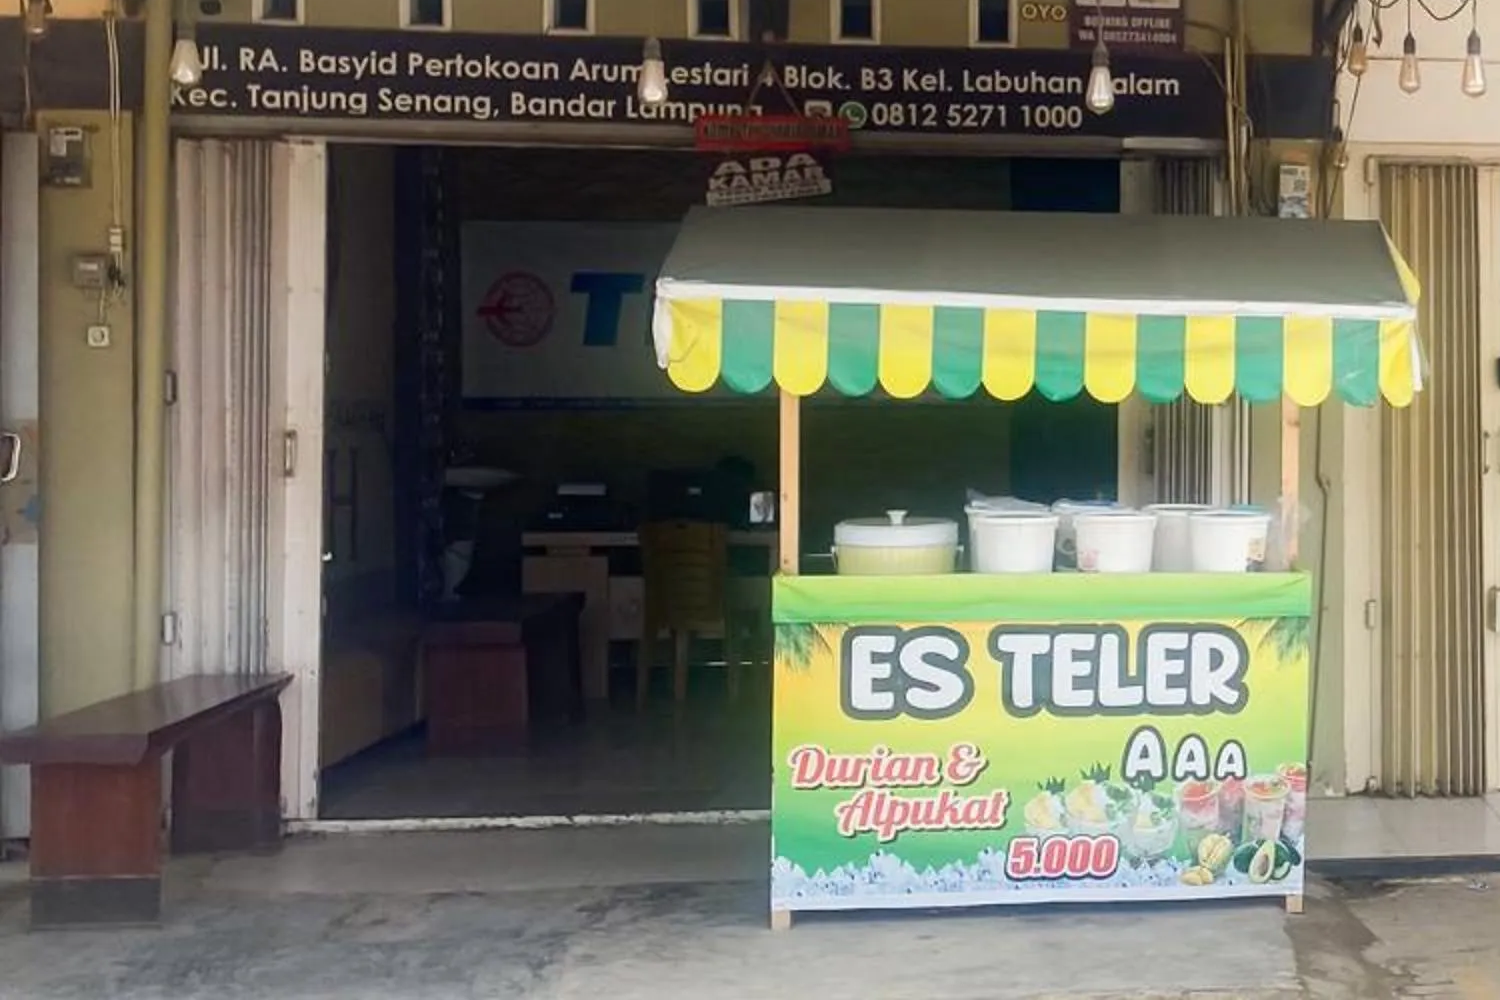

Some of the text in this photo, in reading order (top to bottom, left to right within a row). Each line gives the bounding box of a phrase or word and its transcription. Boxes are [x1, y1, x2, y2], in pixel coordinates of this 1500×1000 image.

[1021, 2, 1068, 21] OYO
[239, 47, 288, 73] RA.
[299, 49, 397, 81] Basyid
[408, 52, 559, 80] Pertokoan
[663, 62, 749, 87] estari
[784, 65, 851, 91] Blok.
[860, 67, 894, 92] B3
[903, 69, 953, 93] Kel.
[963, 69, 1083, 95] Labuhan
[1111, 72, 1180, 97] alam
[170, 82, 237, 108] Kec.
[247, 84, 367, 115] Tanjung
[377, 87, 500, 119] Senang,
[510, 91, 616, 119] Bandar
[872, 103, 1083, 130] 0812 5271 1000
[708, 165, 824, 192] KAMAR
[713, 153, 818, 176] ADA
[846, 628, 1245, 714] ES TELER
[791, 743, 984, 786] Durian &
[838, 789, 1010, 839] Alpukat
[1008, 835, 1119, 876] 5.000
